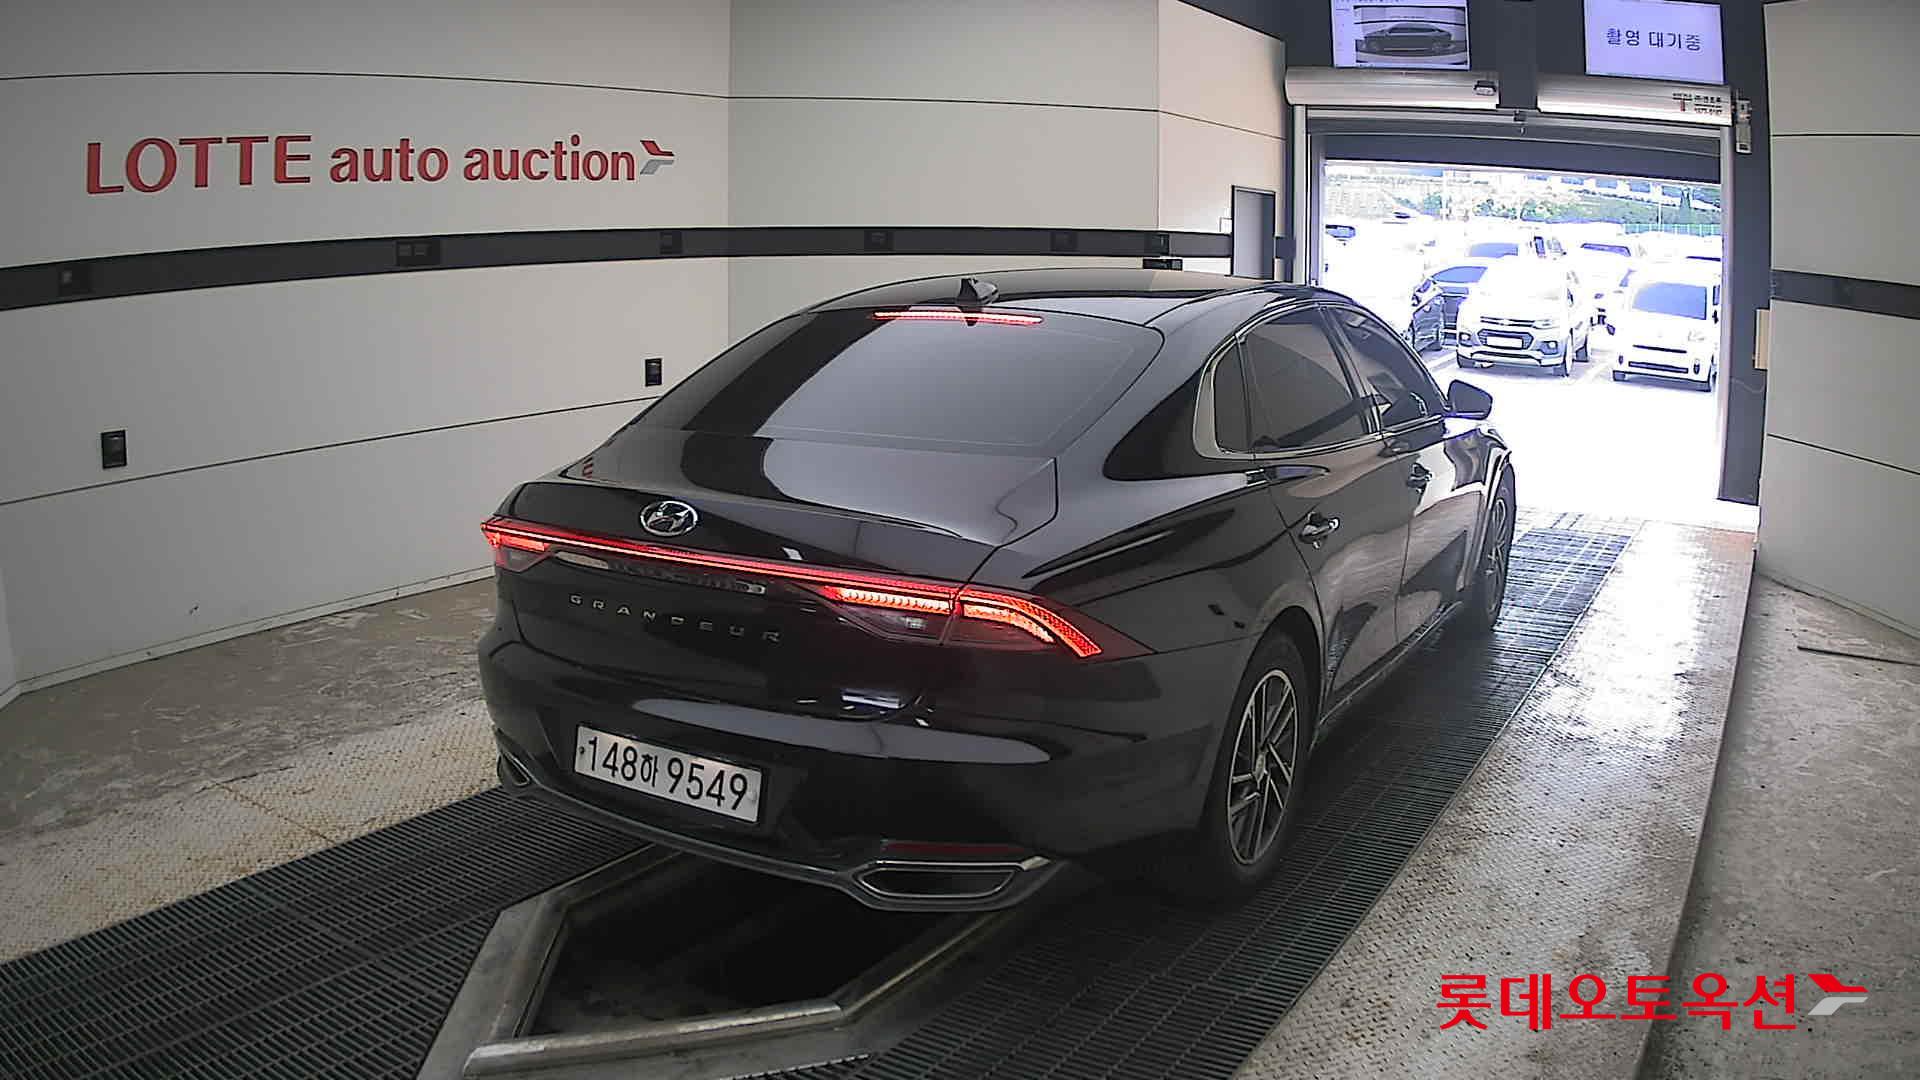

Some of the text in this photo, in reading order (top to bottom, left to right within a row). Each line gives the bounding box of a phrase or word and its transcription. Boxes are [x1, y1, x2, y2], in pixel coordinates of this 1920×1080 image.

[1607, 27, 1701, 52] 촬영 대기중
[86, 133, 636, 194] LOTTE auto auction
[568, 593, 782, 643] GRANDEUR
[588, 735, 749, 811] 148하 9549
